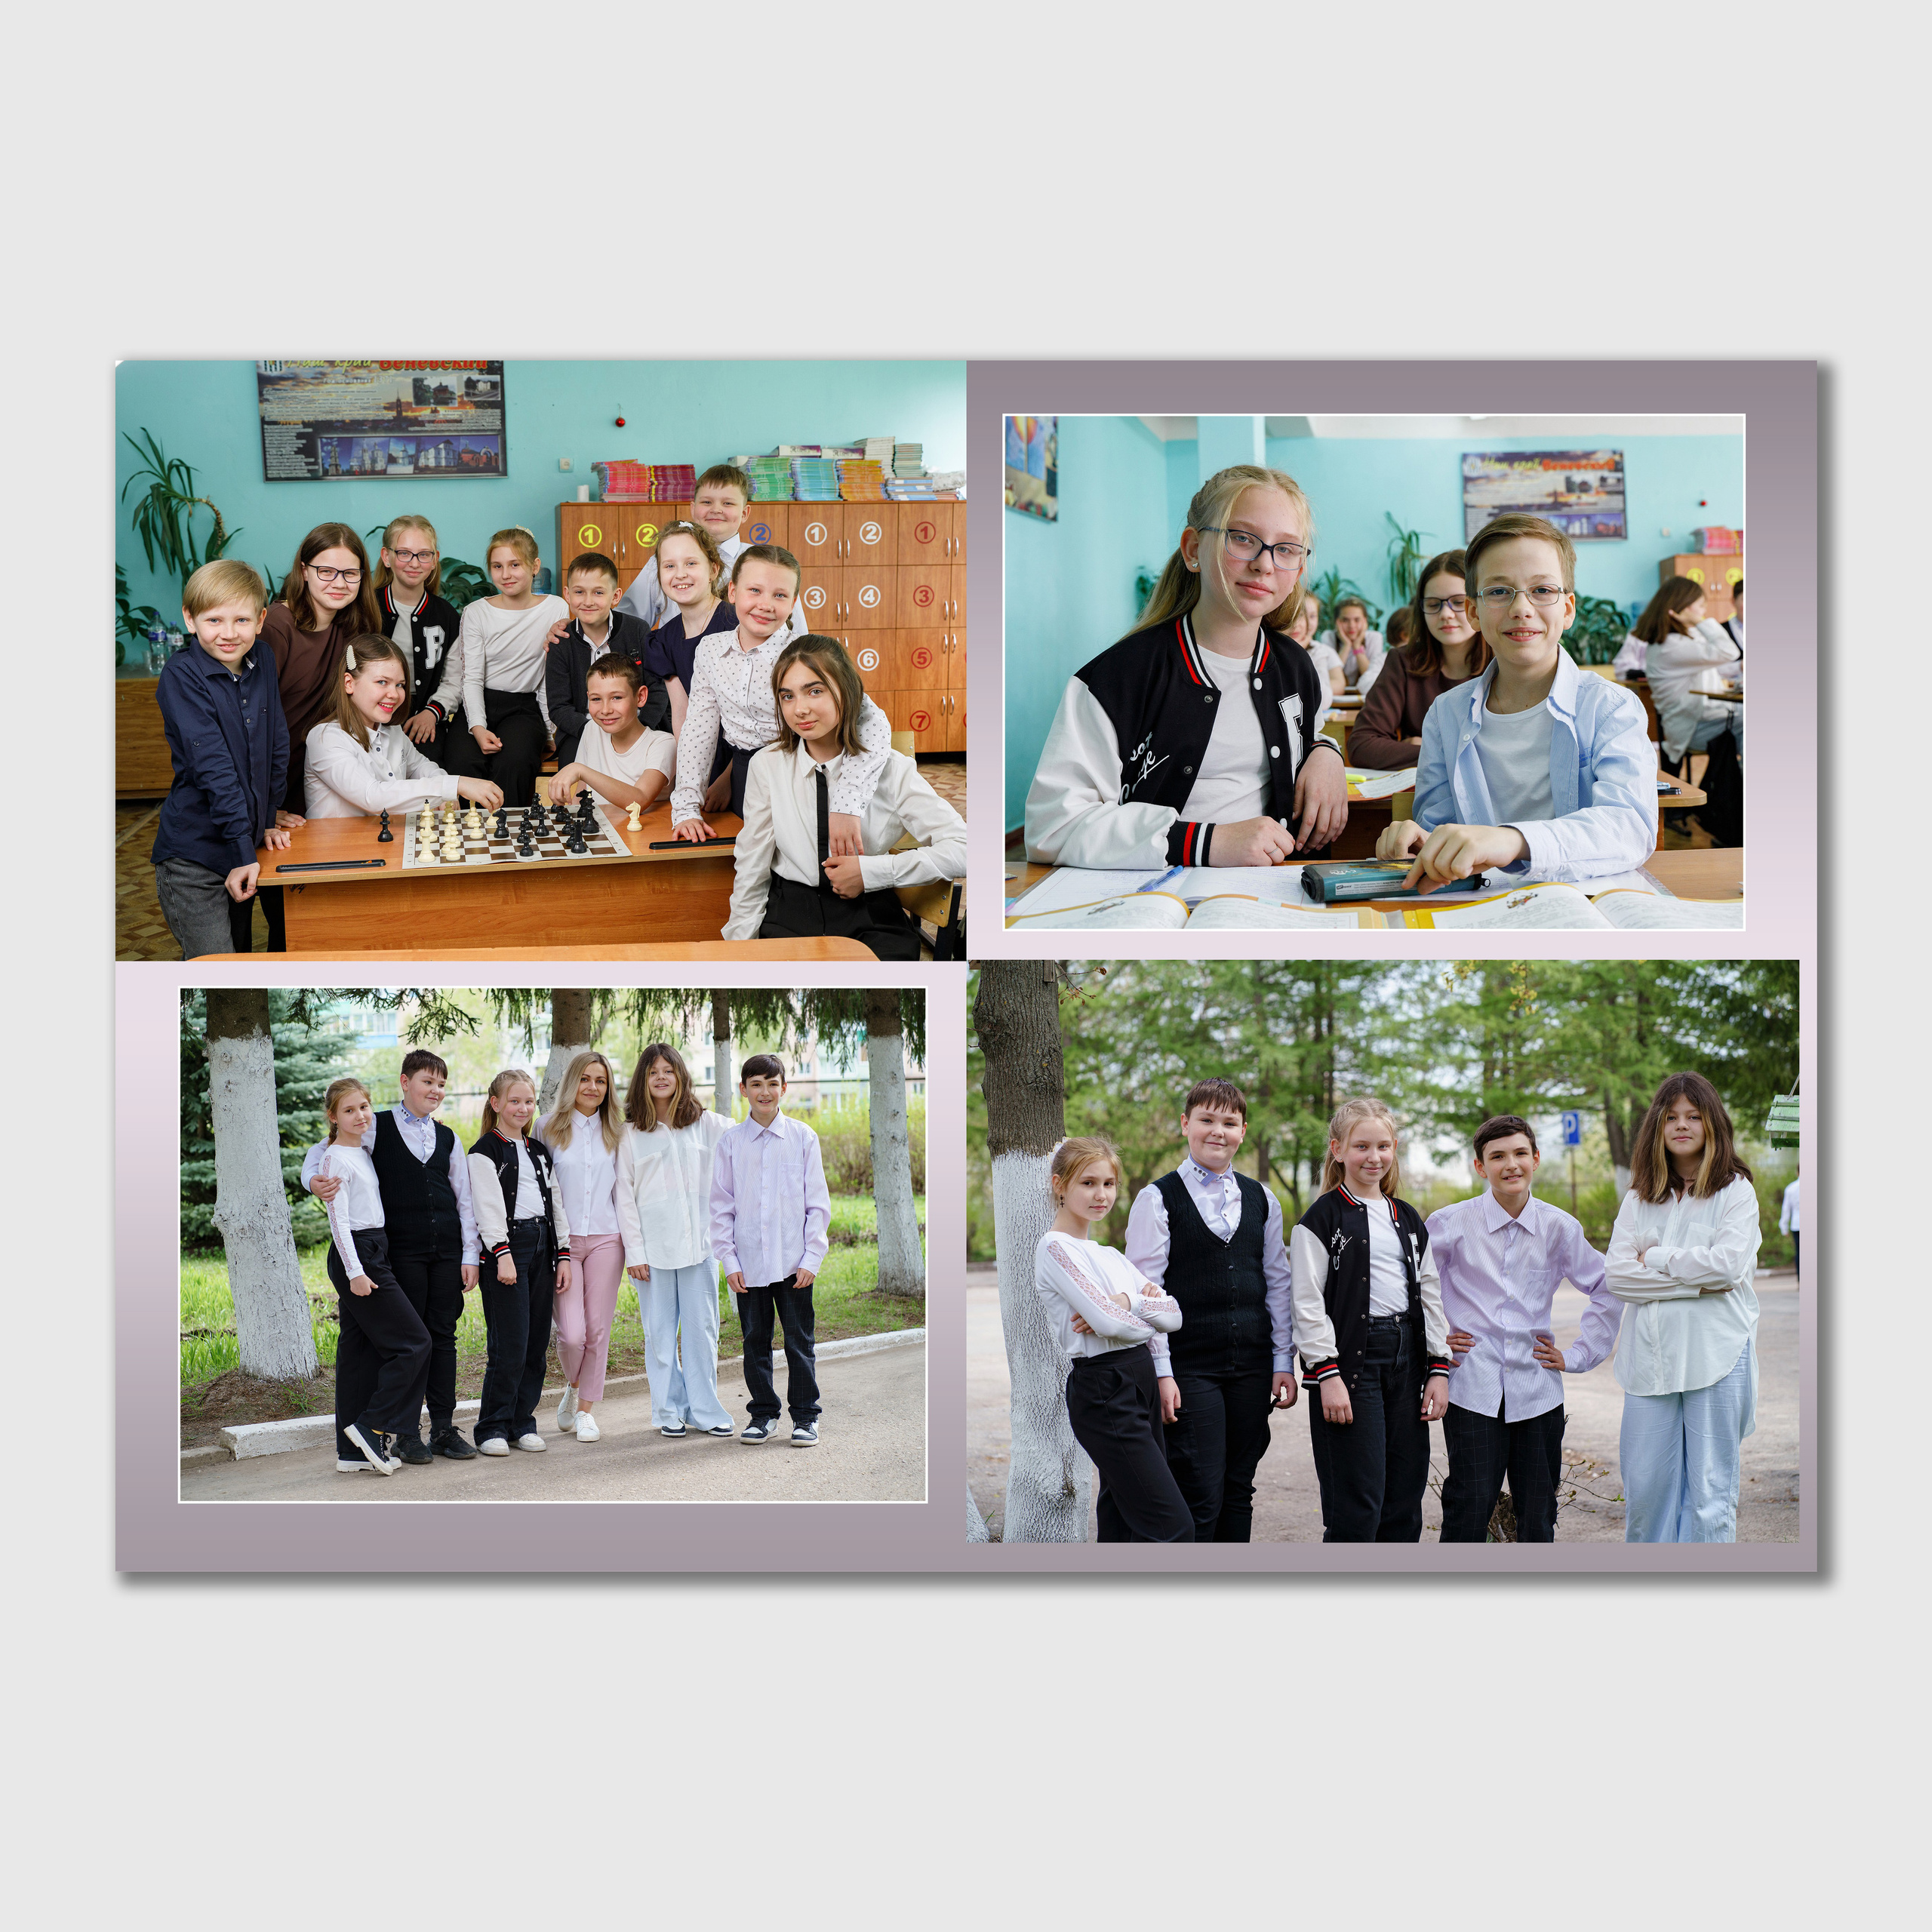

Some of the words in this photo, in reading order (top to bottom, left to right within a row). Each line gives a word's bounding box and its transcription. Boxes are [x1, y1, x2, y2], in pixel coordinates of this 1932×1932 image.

[584, 528, 593, 543] 1
[642, 528, 654, 543] 2
[755, 527, 767, 541] 2
[811, 527, 820, 541] 1
[866, 525, 877, 540] 2
[920, 526, 928, 540] 1
[810, 590, 821, 605] 3
[863, 589, 875, 603] 4
[918, 589, 929, 603] 3
[863, 652, 875, 667] 6
[917, 651, 927, 665] 5
[915, 715, 927, 728] 7
[1564, 1114, 1577, 1143] P
